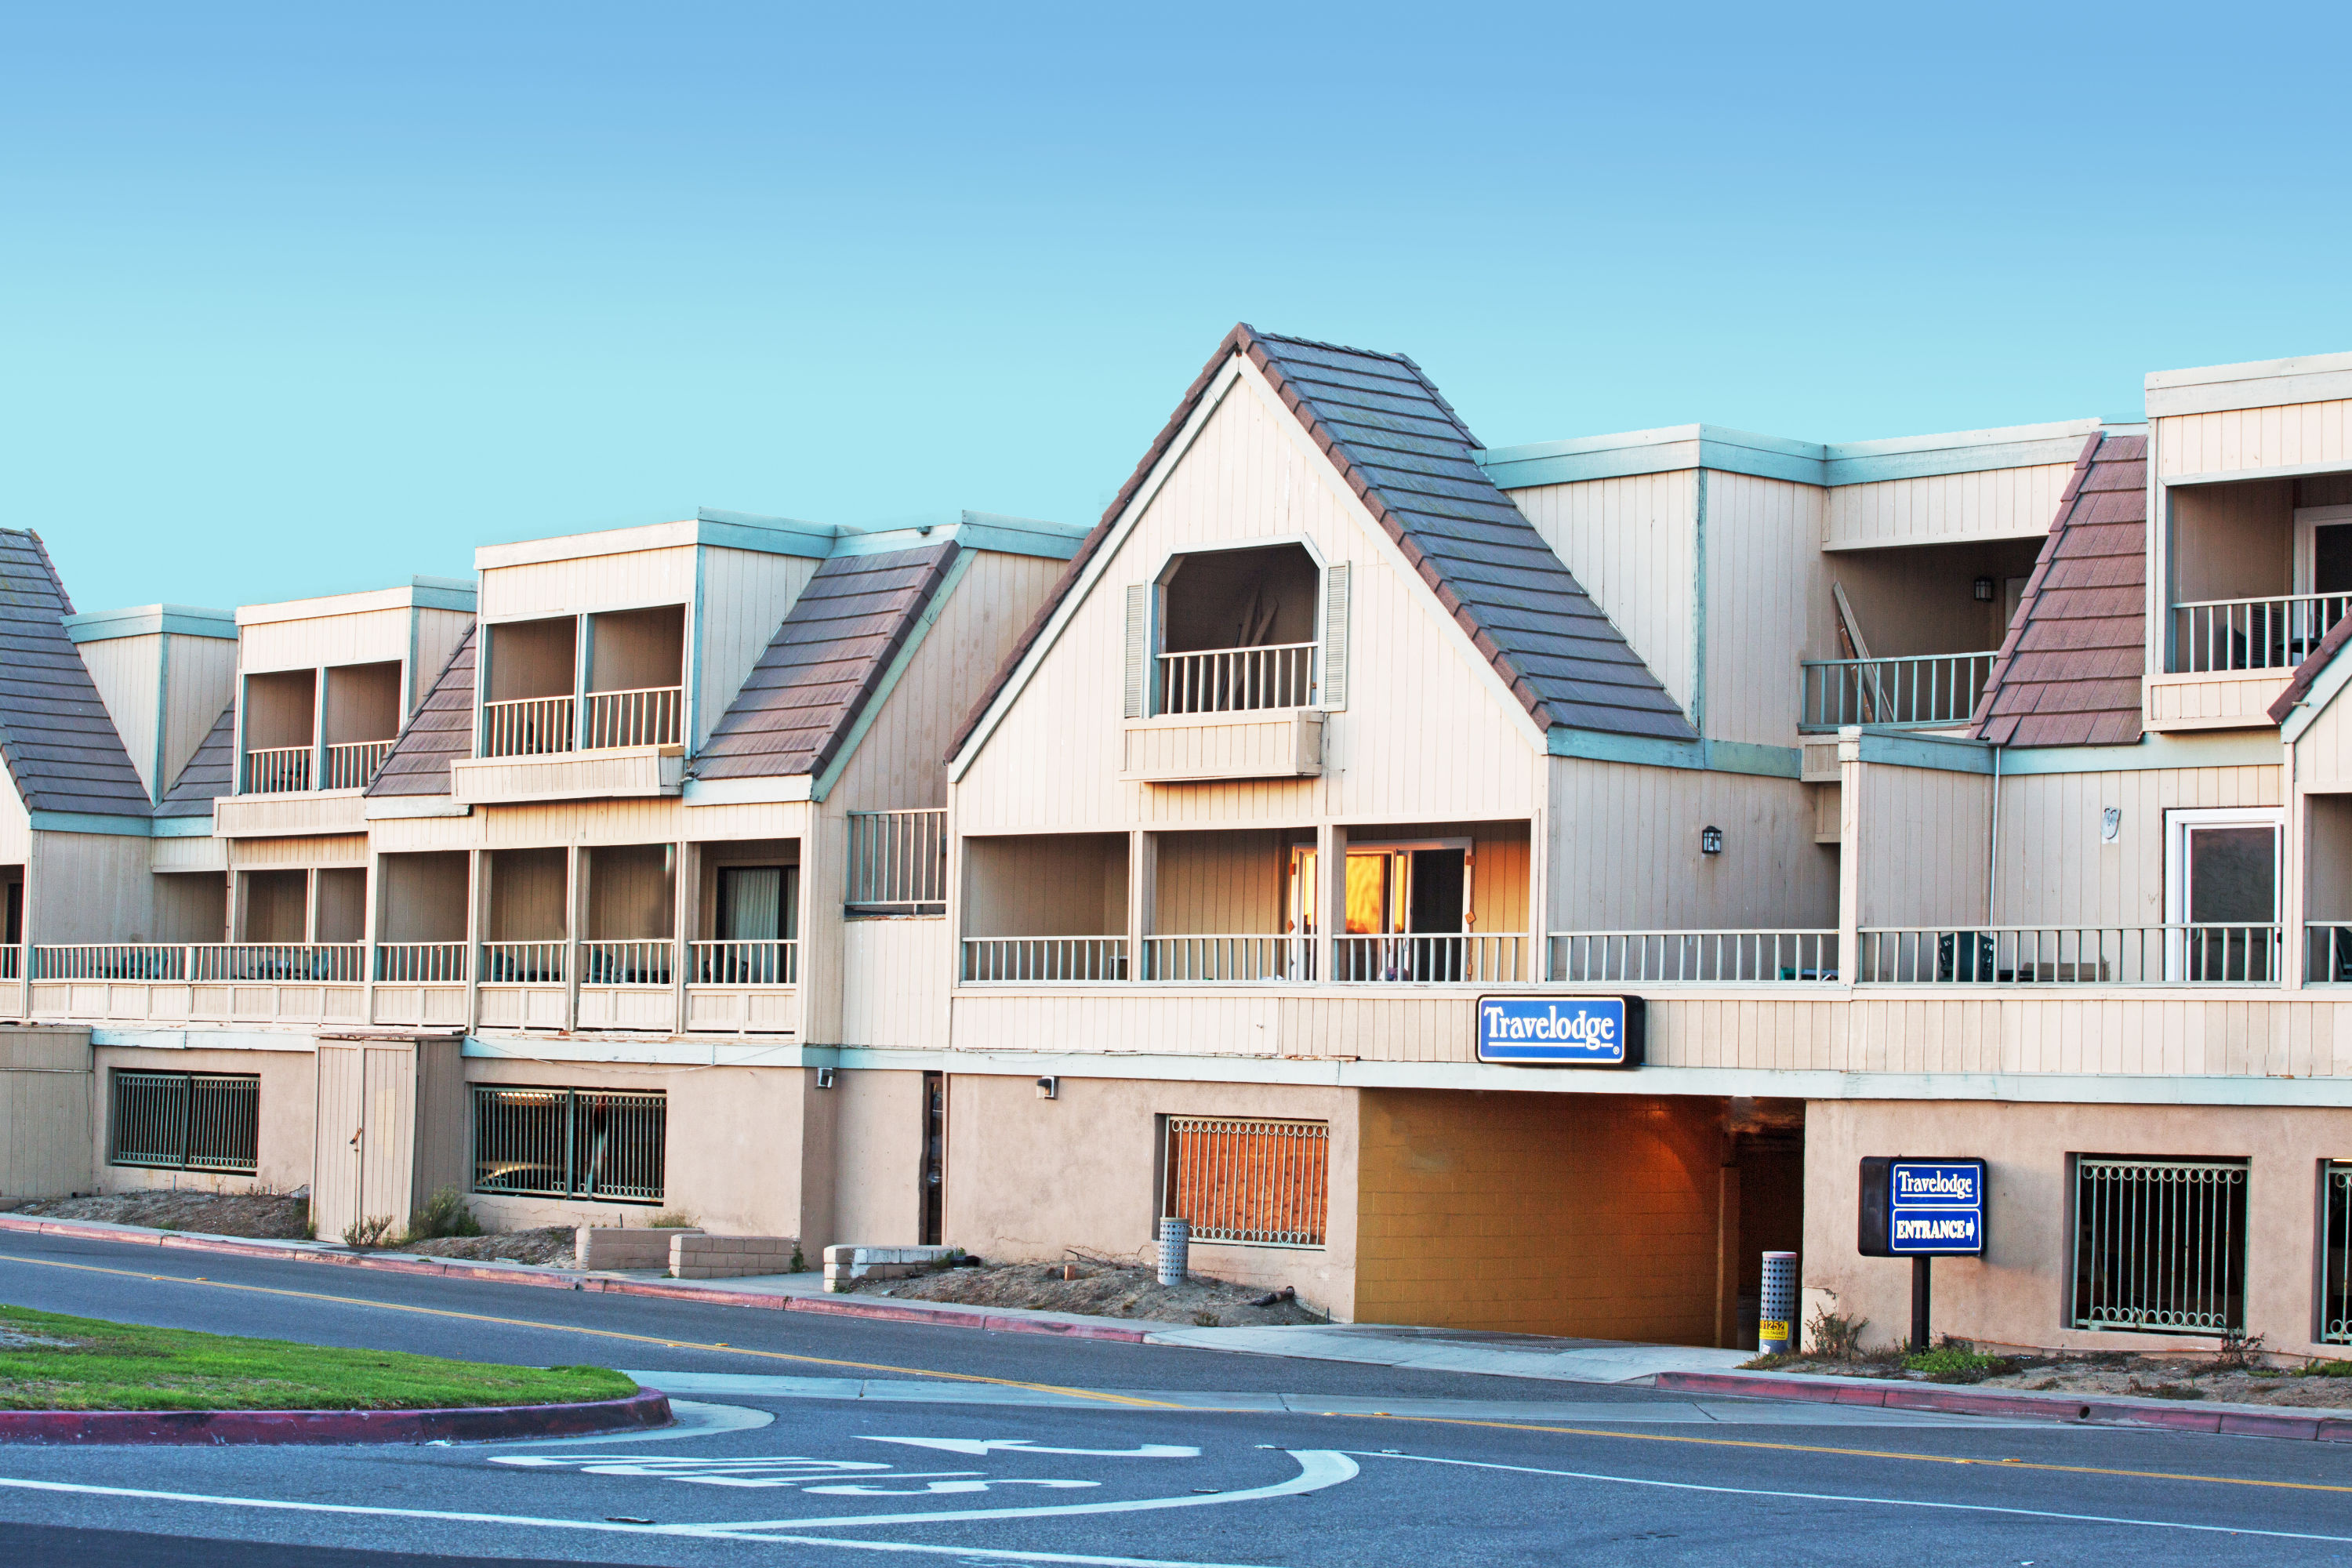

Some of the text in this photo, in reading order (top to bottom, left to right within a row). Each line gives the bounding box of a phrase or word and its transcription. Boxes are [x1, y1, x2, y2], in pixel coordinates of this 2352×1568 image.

[1484, 1005, 1614, 1051] Travelodge
[1898, 1171, 1973, 1200] Travelodge
[1896, 1220, 1965, 1240] ENTRANCE
[486, 1454, 1103, 1496] STOP
